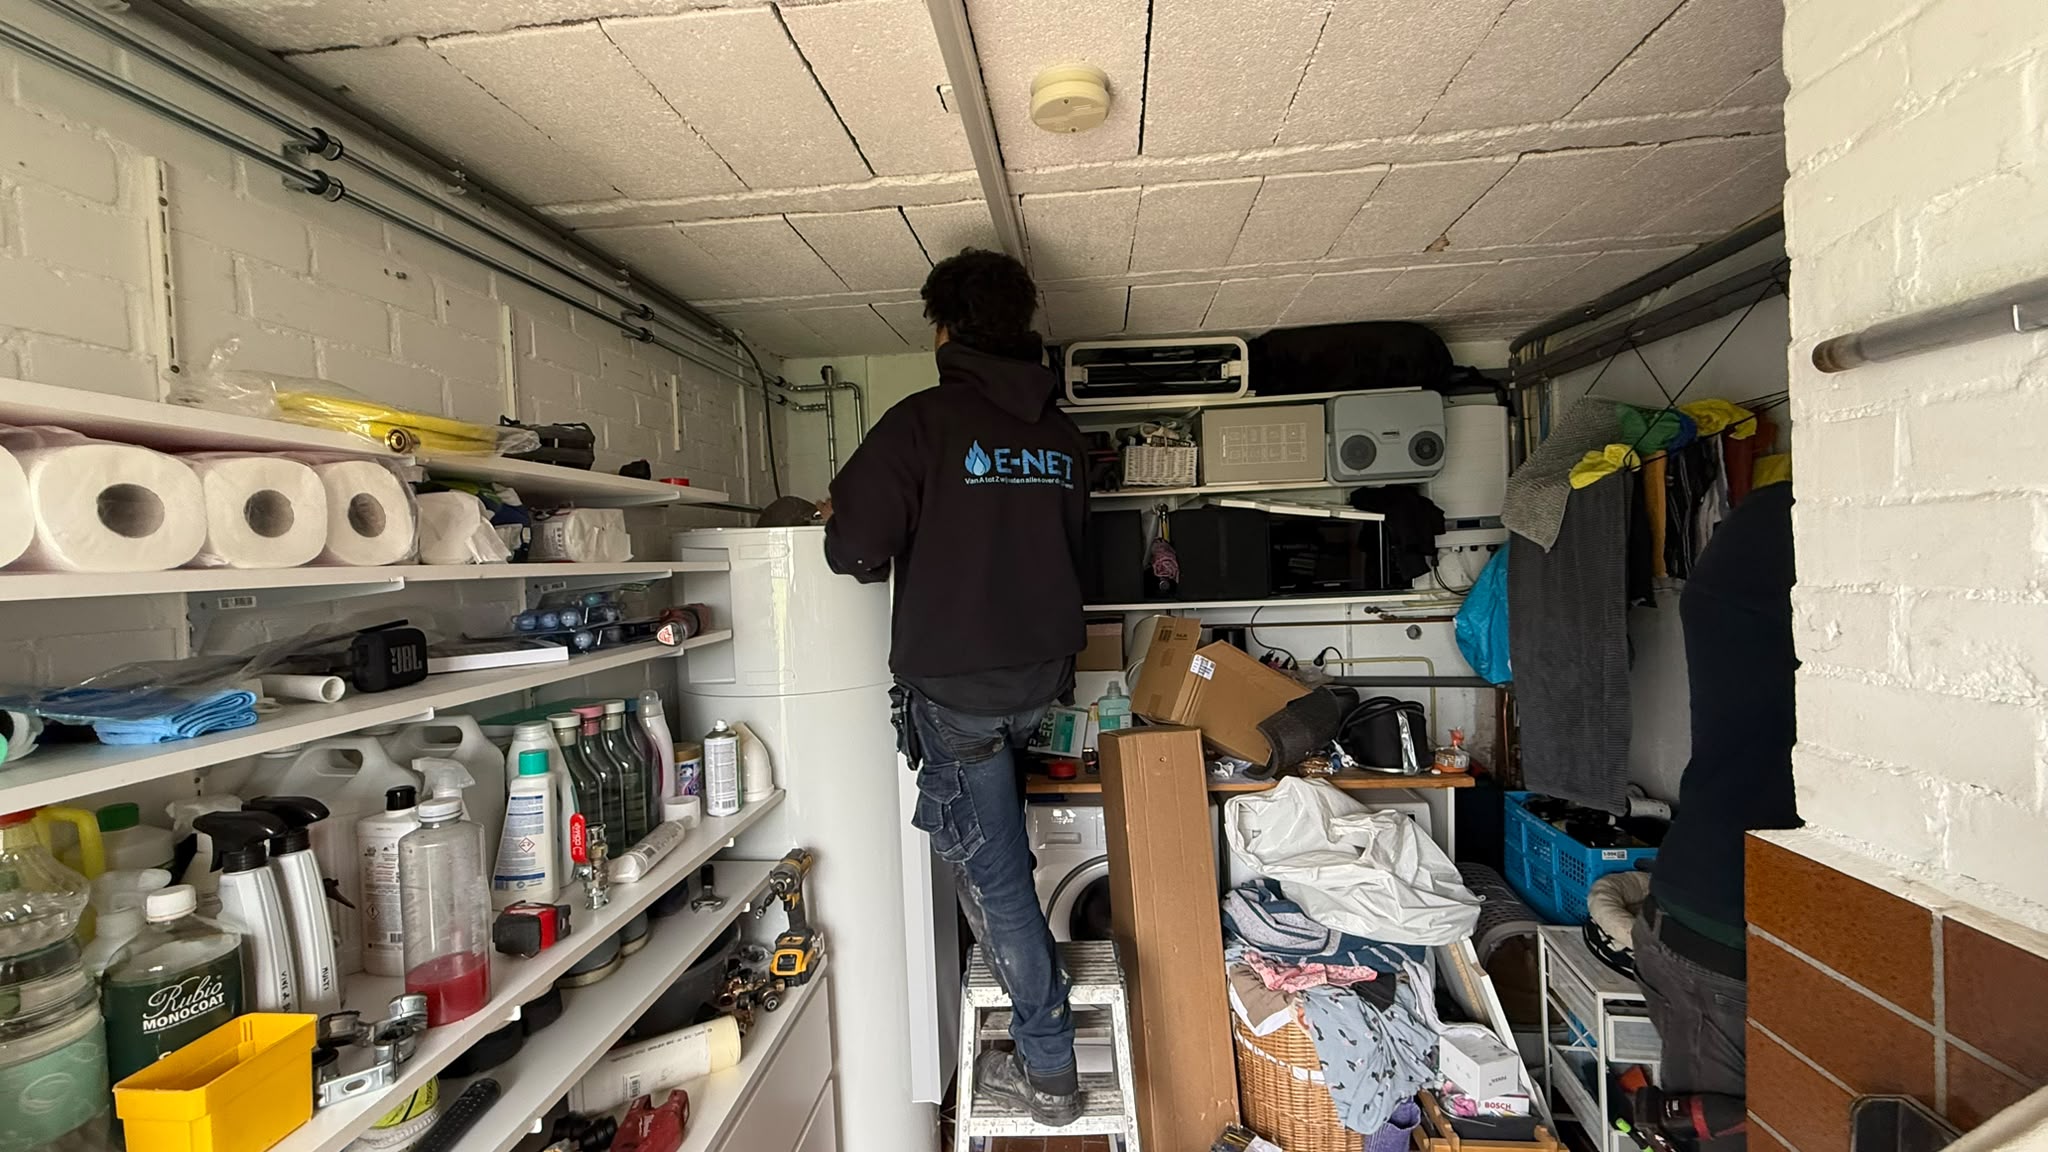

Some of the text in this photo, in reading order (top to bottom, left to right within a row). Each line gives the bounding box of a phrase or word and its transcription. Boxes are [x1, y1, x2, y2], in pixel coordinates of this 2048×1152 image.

[993, 448, 1073, 480] E-NET
[389, 644, 423, 674] JBL
[142, 974, 223, 1020] Rubio
[142, 992, 225, 1031] MONOCOAT
[1484, 1101, 1512, 1110] BOSCH
